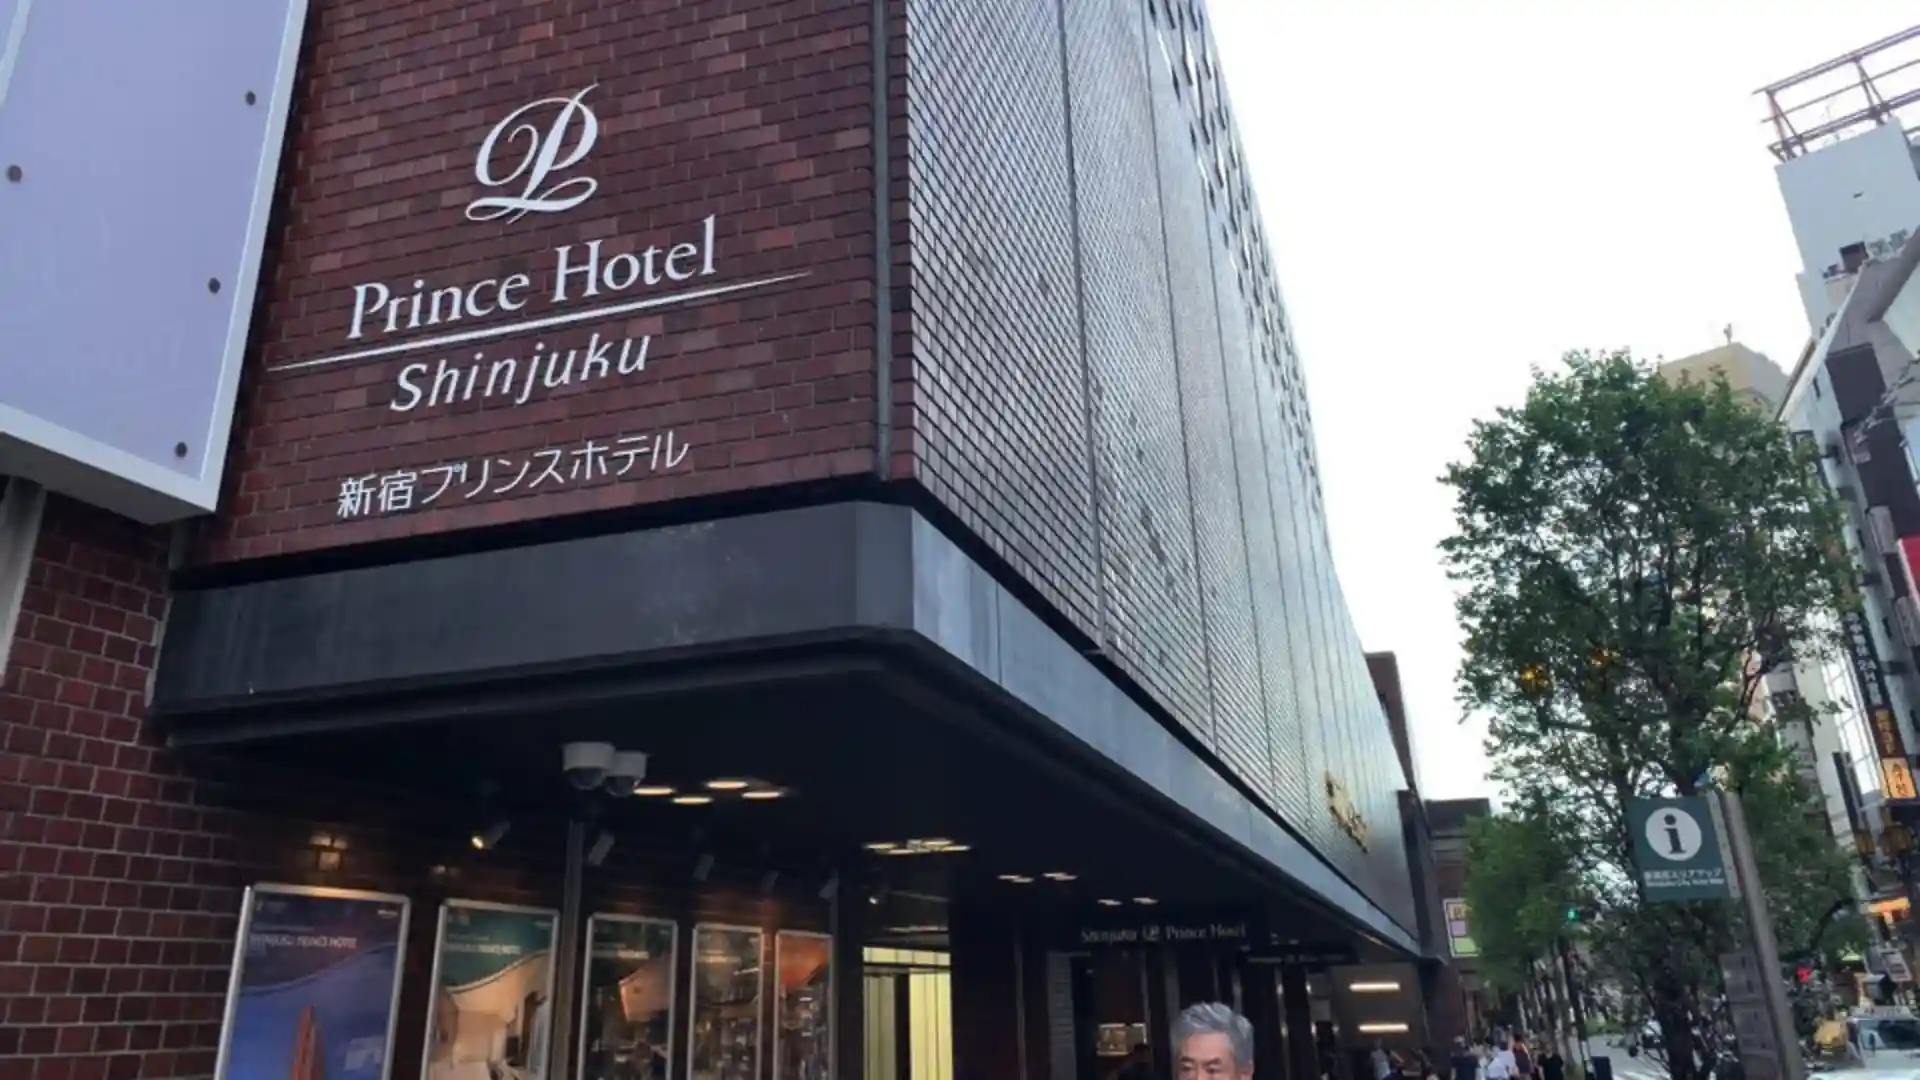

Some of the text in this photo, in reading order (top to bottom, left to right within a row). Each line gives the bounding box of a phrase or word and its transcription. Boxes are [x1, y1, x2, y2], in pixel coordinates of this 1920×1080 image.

[348, 215, 717, 340] Prince Hotel
[389, 332, 651, 412] Shinjuku
[336, 430, 690, 519] 新宿プリンスホテル
